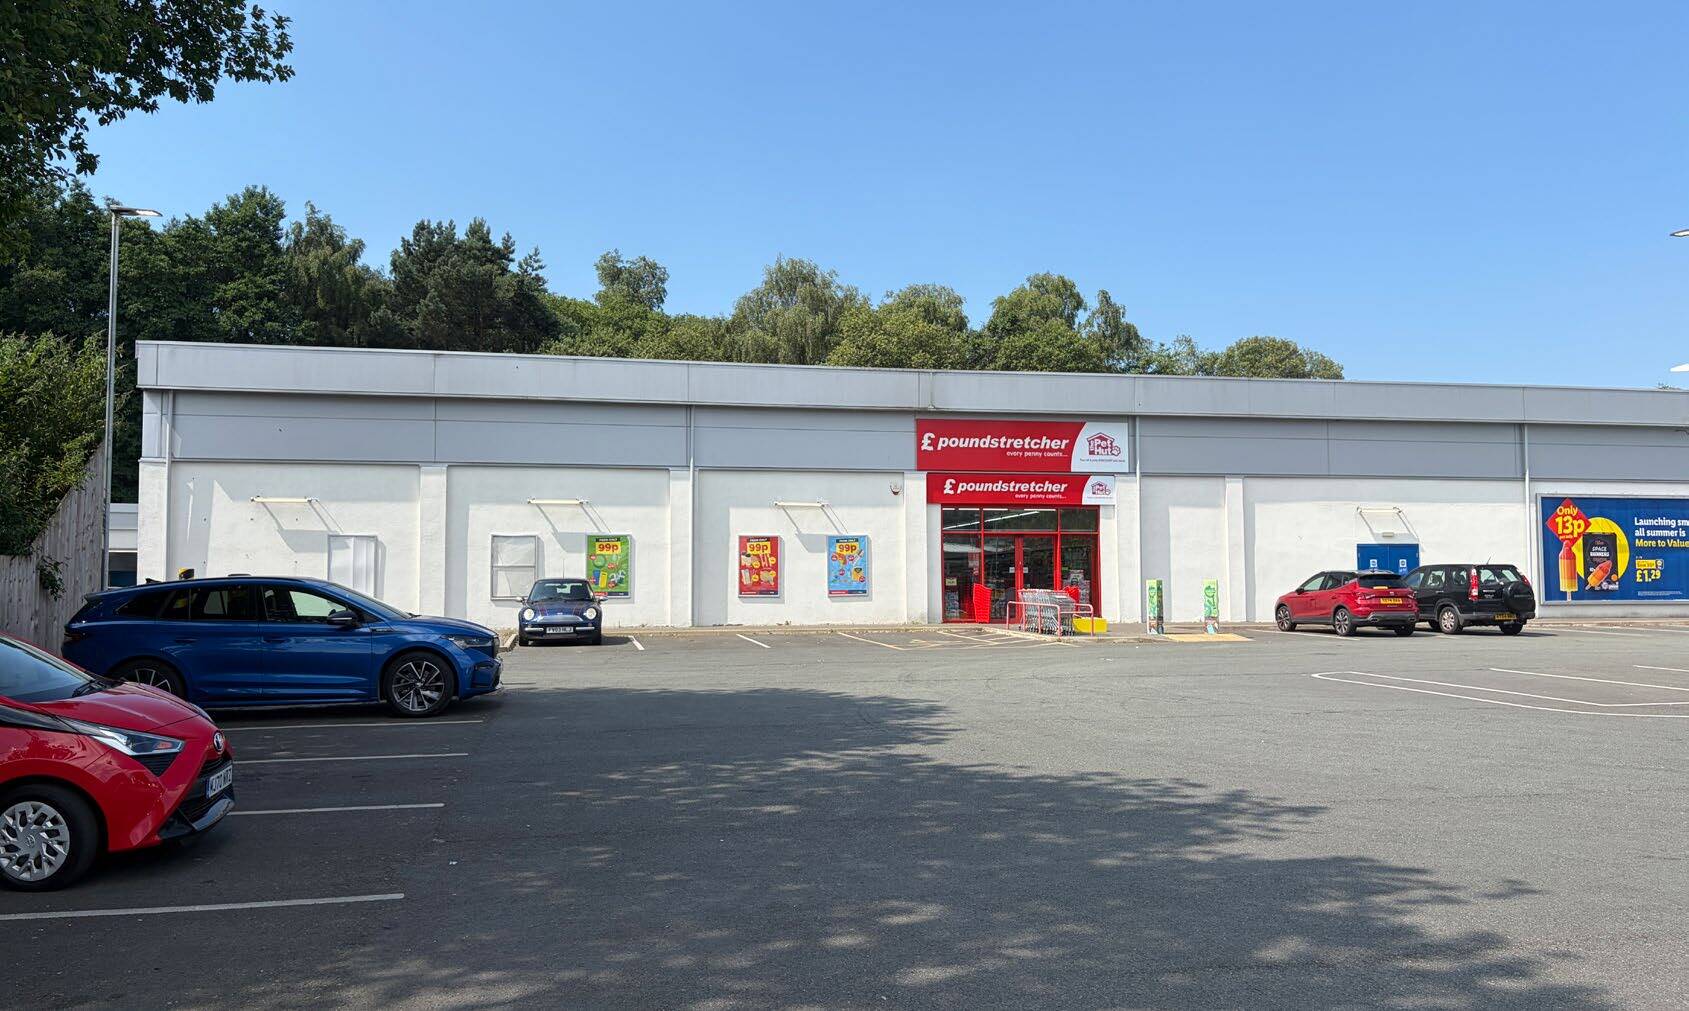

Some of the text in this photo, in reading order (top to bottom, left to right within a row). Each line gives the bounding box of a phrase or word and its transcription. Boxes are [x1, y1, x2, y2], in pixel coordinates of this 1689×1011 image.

[937, 435, 1069, 450] poundstretcher
[957, 480, 1068, 494] poundstretcher
[1556, 505, 1578, 516] Only
[1555, 515, 1585, 537] 13p
[1635, 517, 1676, 528] Launching
[1635, 527, 1686, 537] all summer is
[598, 543, 619, 552] 99p
[748, 543, 769, 553] 99p
[838, 543, 857, 553] 99p
[1636, 539, 1656, 547] More
[1657, 539, 1666, 547] to
[1636, 569, 1661, 582] £1.29
